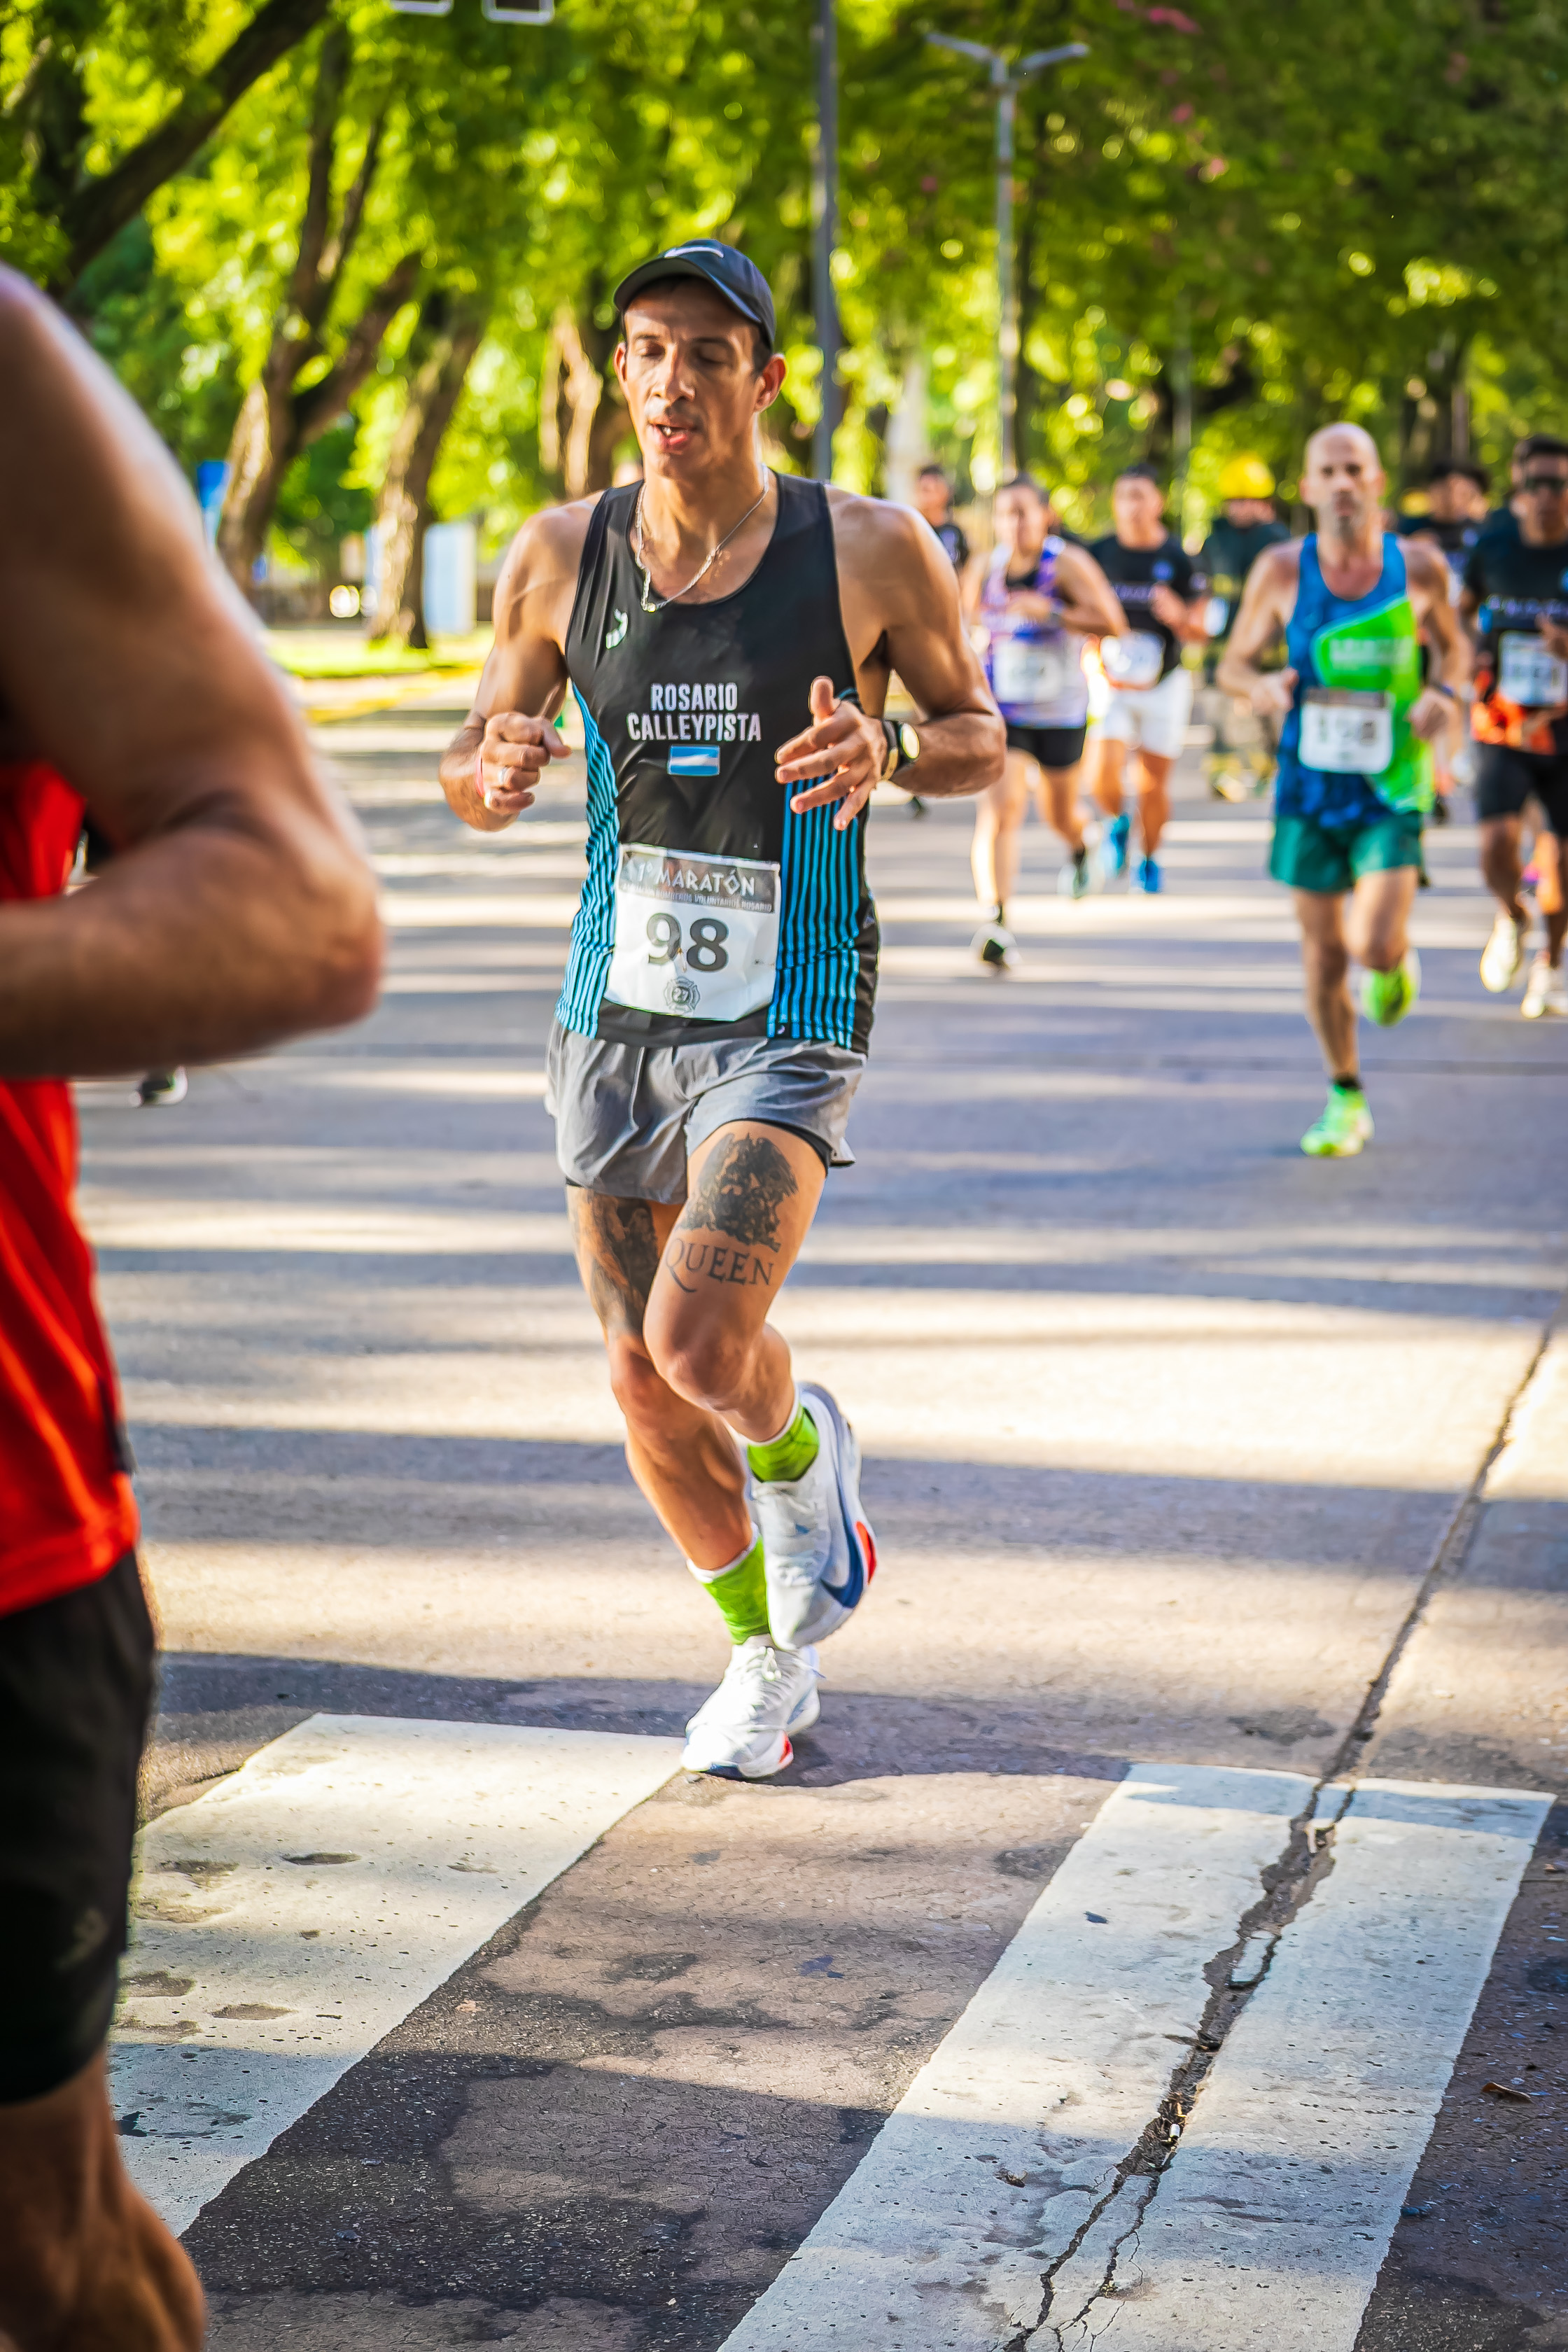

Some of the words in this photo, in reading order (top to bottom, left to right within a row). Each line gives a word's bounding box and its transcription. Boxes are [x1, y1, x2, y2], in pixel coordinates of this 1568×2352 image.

[651, 682, 738, 711] ROSARIO
[626, 713, 762, 742] CALLEYPISTA
[655, 867, 755, 896] MARATÓN
[647, 913, 729, 972] 98
[666, 1238, 774, 1292] QUEEN
